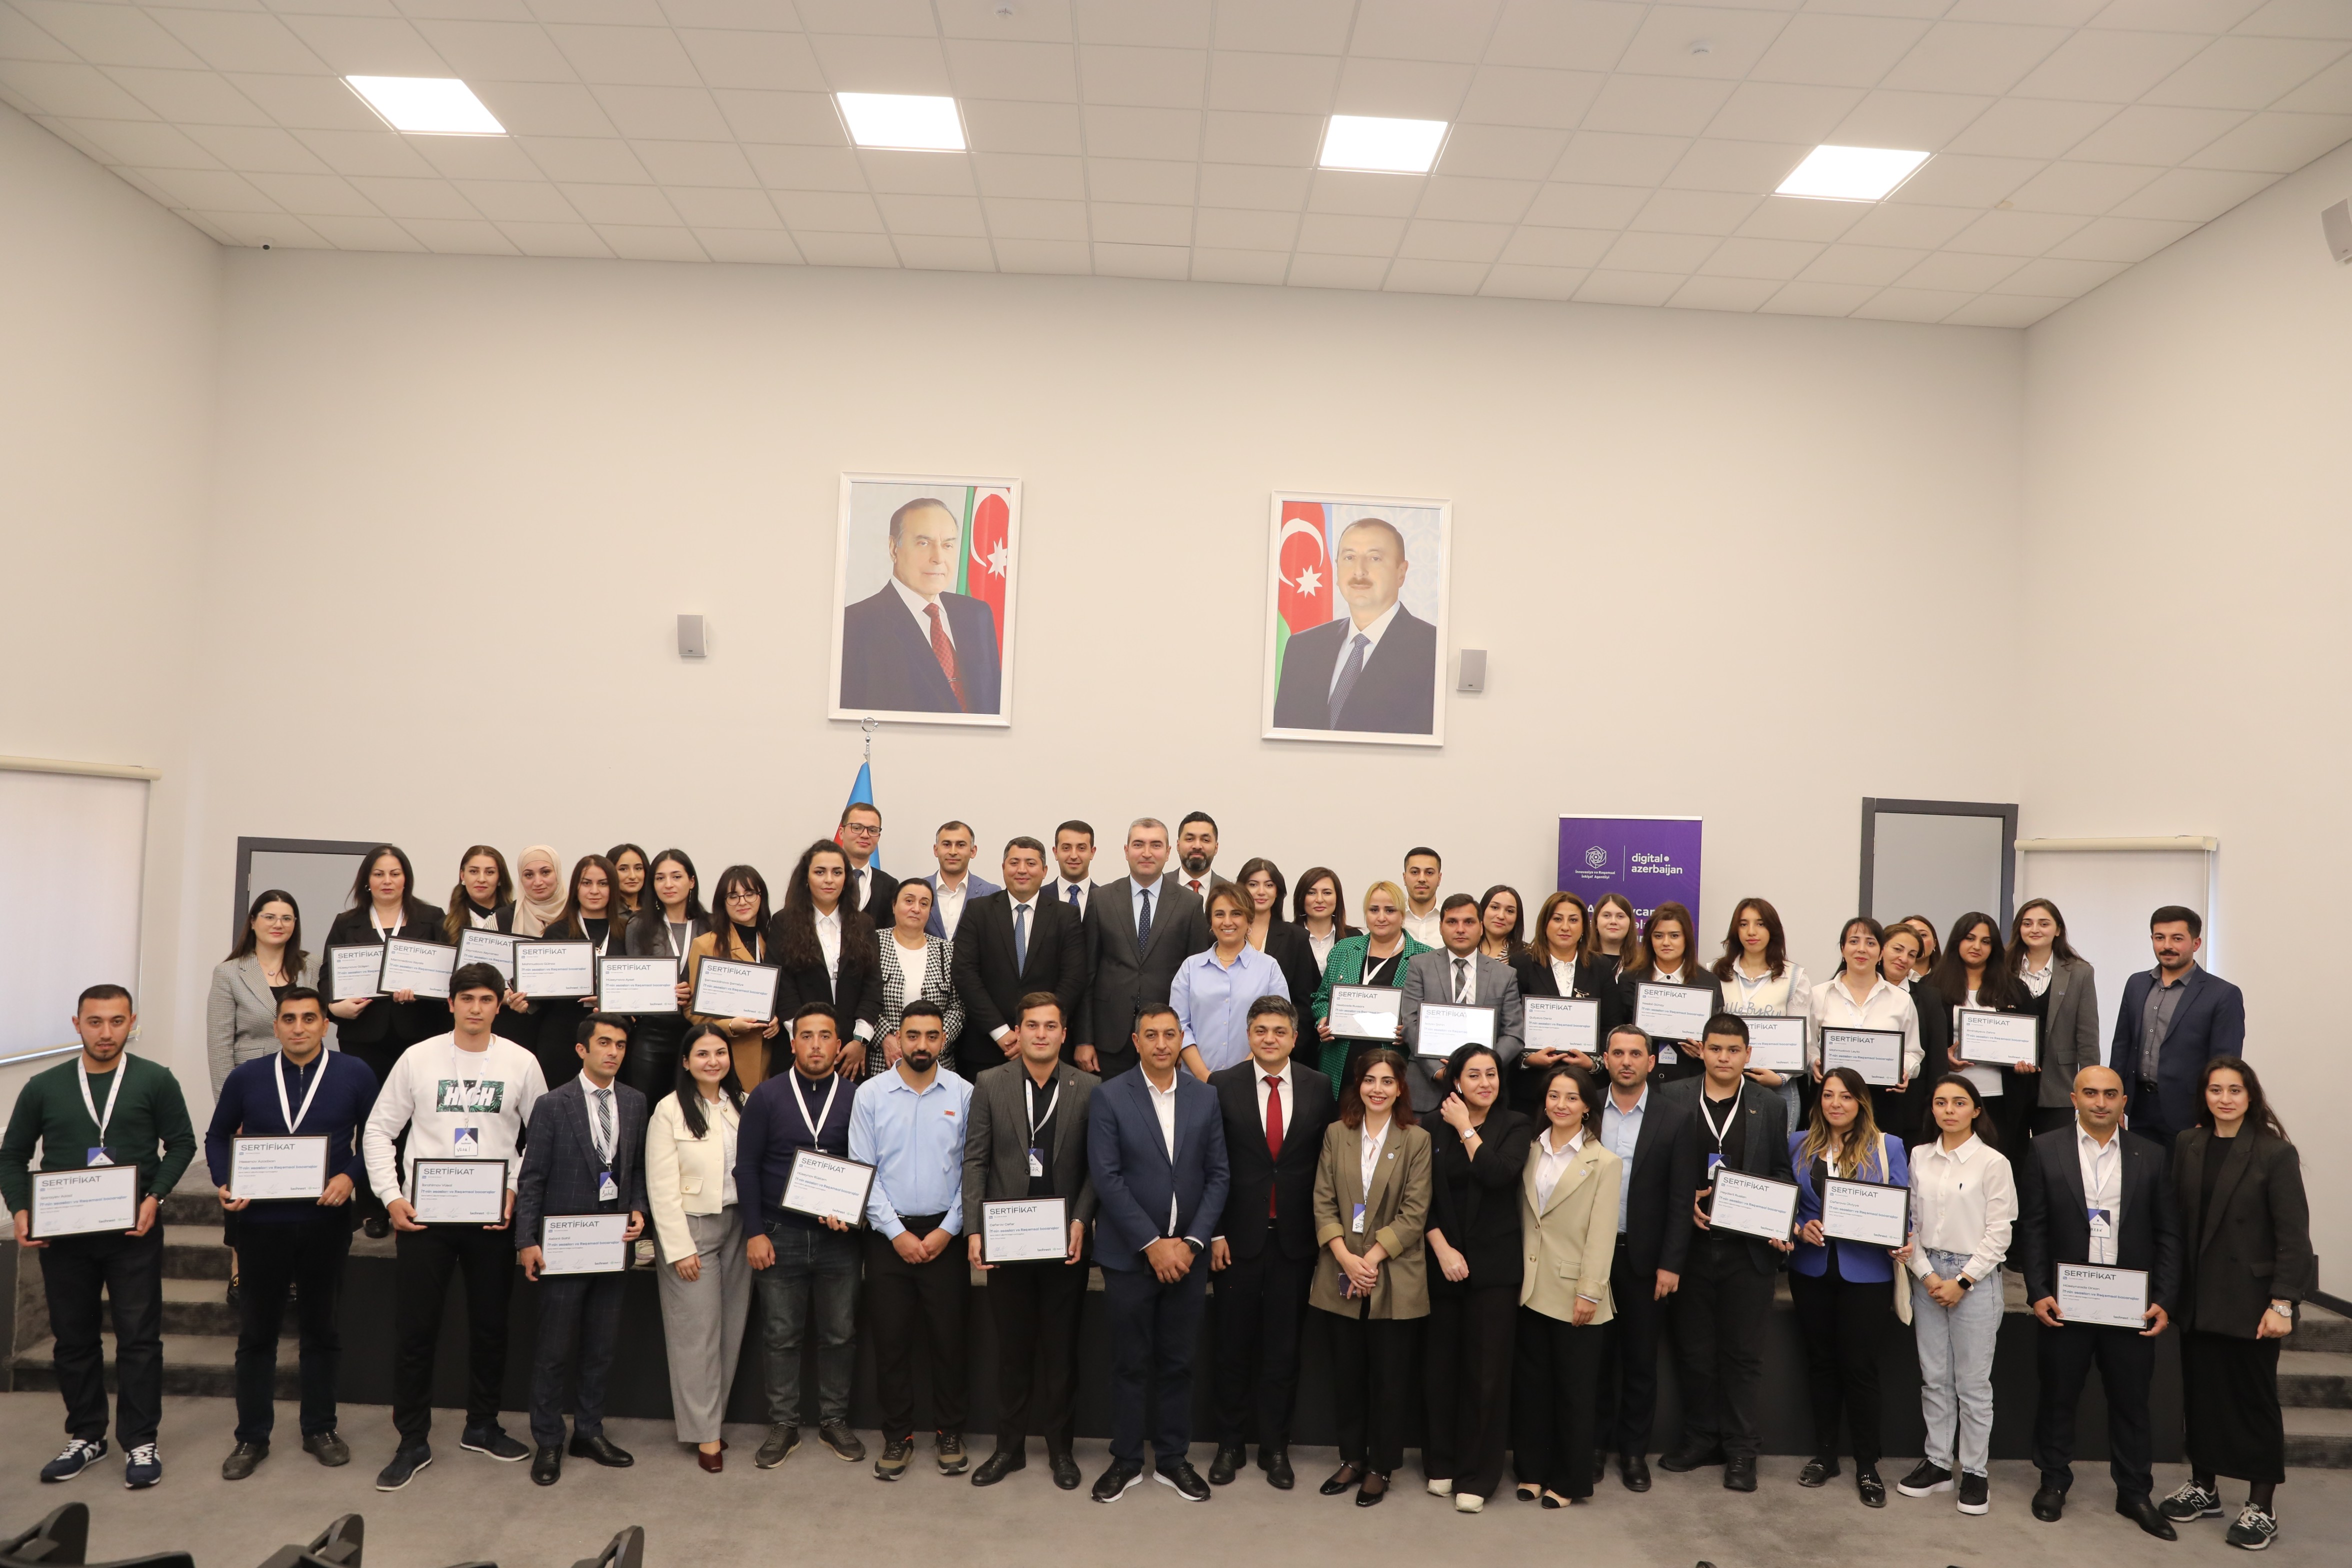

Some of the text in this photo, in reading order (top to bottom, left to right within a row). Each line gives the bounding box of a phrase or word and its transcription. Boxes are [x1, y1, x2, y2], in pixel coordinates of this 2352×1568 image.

[1632, 853, 1662, 864] digital
[1632, 864, 1682, 876] azerbaijan
[468, 936, 512, 947] SERTİFİKAT
[338, 950, 384, 958] SERTİFİKAT
[394, 945, 437, 956] SERTİFİKAT
[707, 966, 751, 976] SERTİFİKAT
[1644, 990, 1687, 998] SERTİFİKAT
[1968, 1018, 2010, 1026] SERTİFİKAT
[242, 1143, 296, 1151] SERTİFİKAT
[802, 1158, 846, 1173] SERTİFİKAT
[42, 1176, 102, 1187] SERTİFİKAT
[1724, 1177, 1769, 1192] SERTİFİKAT
[1832, 1186, 1878, 1198] SERTİFİKAT
[990, 1206, 1037, 1214] SERTİFİKAT
[550, 1220, 600, 1228] SERTİFİKAT
[2064, 1270, 2116, 1280] SERTİFİKAT
